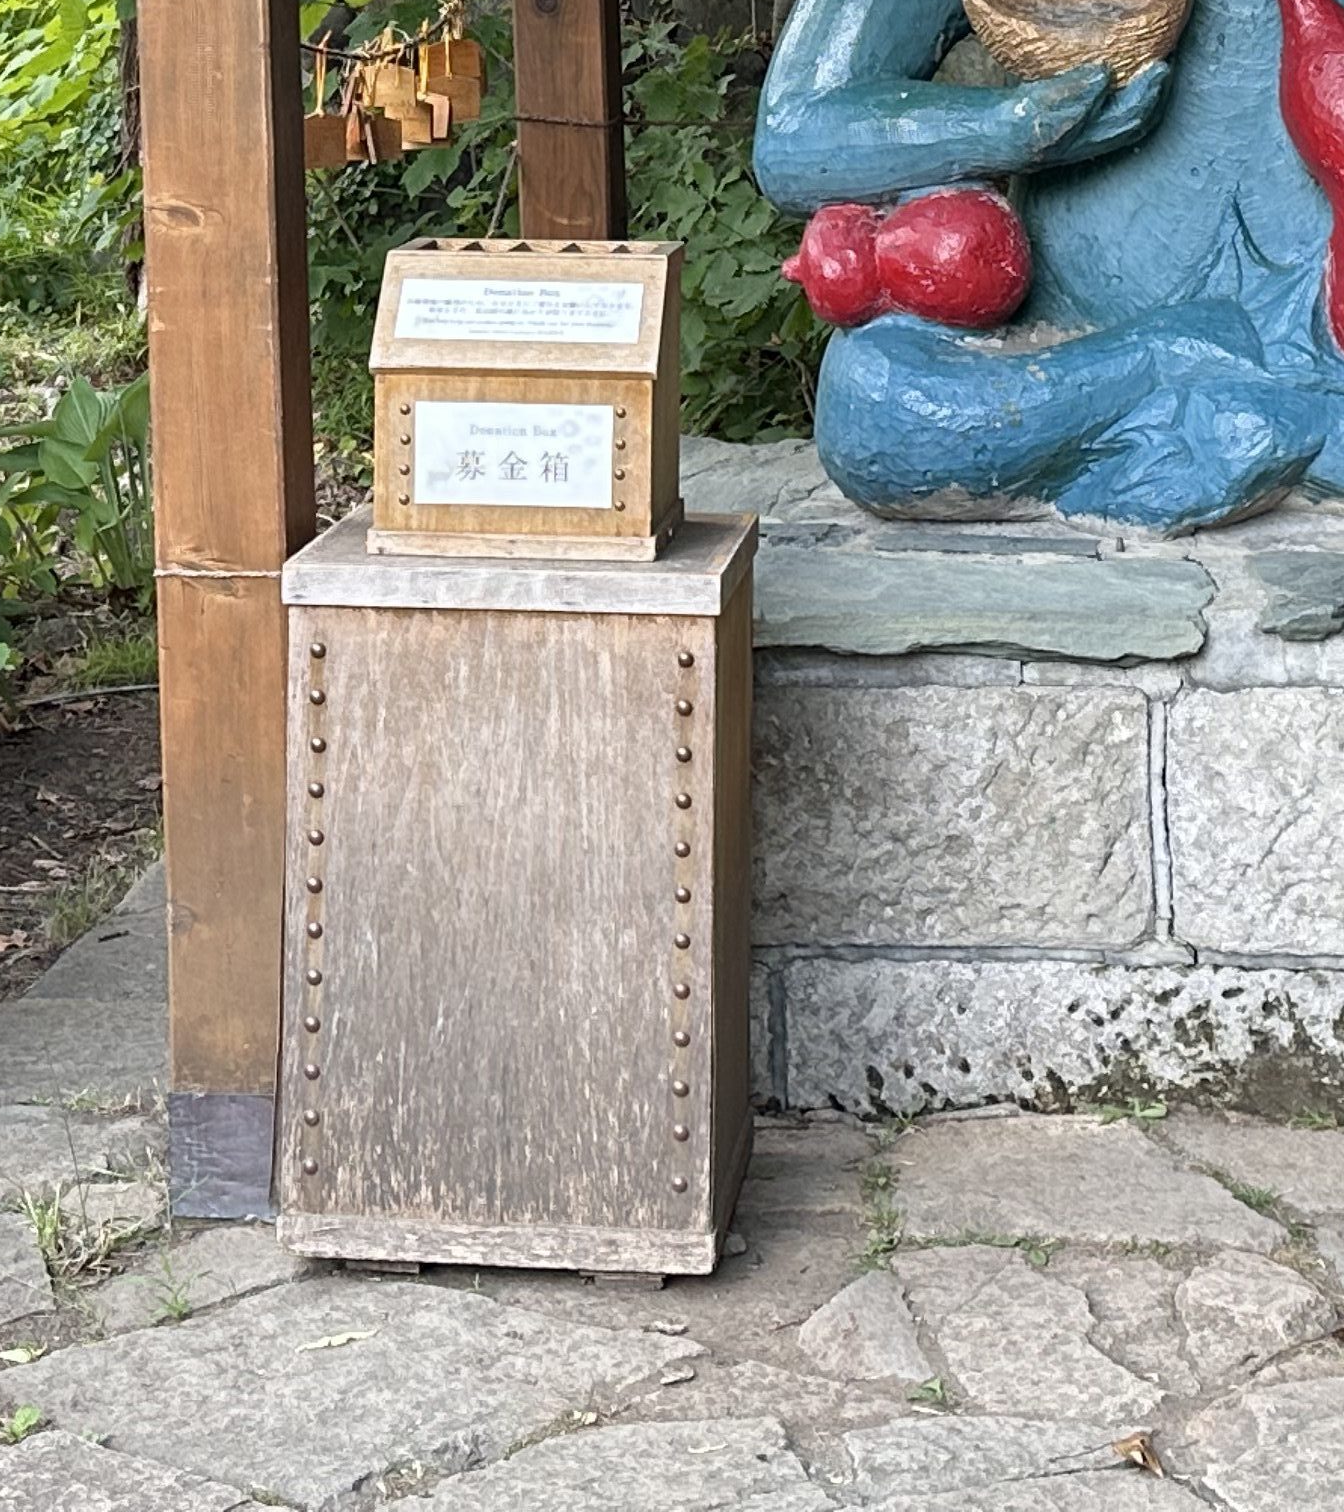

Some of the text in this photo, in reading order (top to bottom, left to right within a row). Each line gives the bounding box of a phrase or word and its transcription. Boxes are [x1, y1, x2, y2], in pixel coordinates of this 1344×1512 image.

[469, 423, 558, 437] Donation Box
[456, 449, 570, 484] 募金箱
